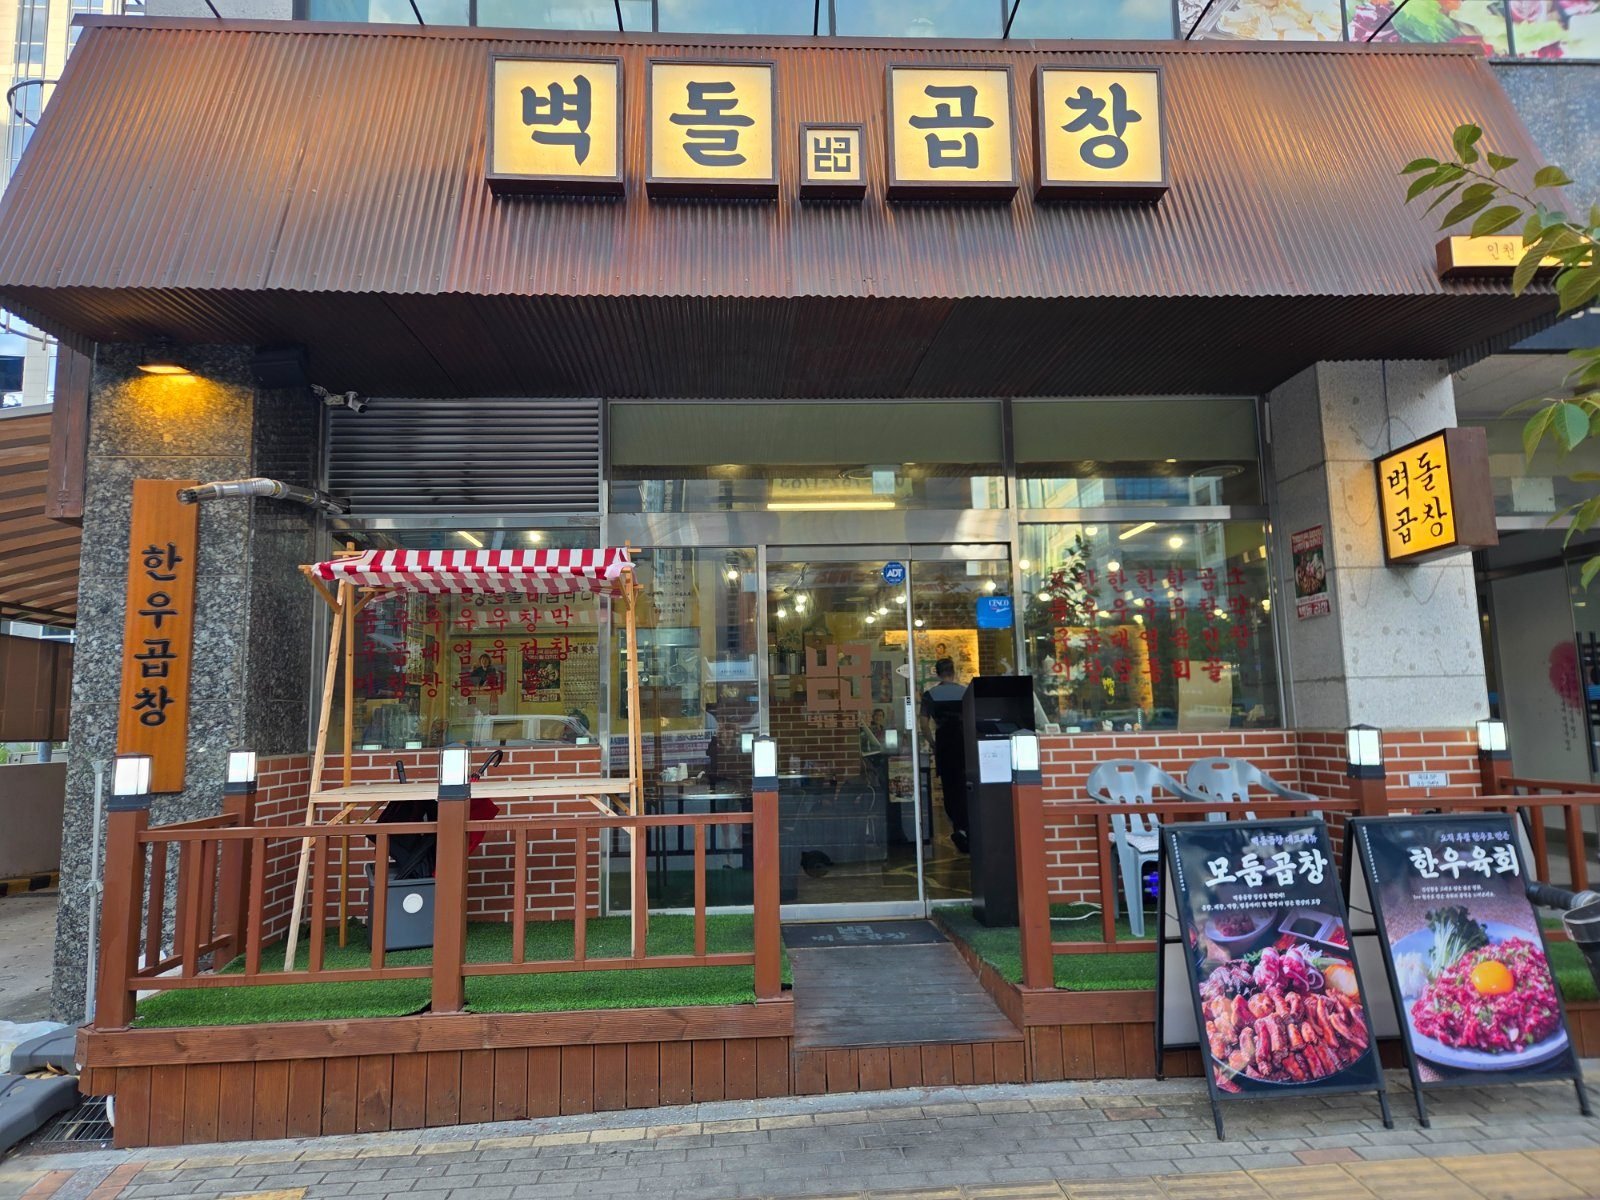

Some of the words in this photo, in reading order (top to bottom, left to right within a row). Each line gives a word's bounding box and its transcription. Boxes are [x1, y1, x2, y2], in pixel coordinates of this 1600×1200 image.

[520, 73, 755, 168] 벽돌
[908, 83, 1143, 171] 곱창
[1386, 450, 1442, 500] 벽돌
[1392, 496, 1448, 545] 곱창
[886, 568, 903, 578] ADT
[132, 542, 183, 726] 한우곱창
[1204, 848, 1328, 889] 모둠곱창
[1407, 843, 1520, 880] 한우육회
